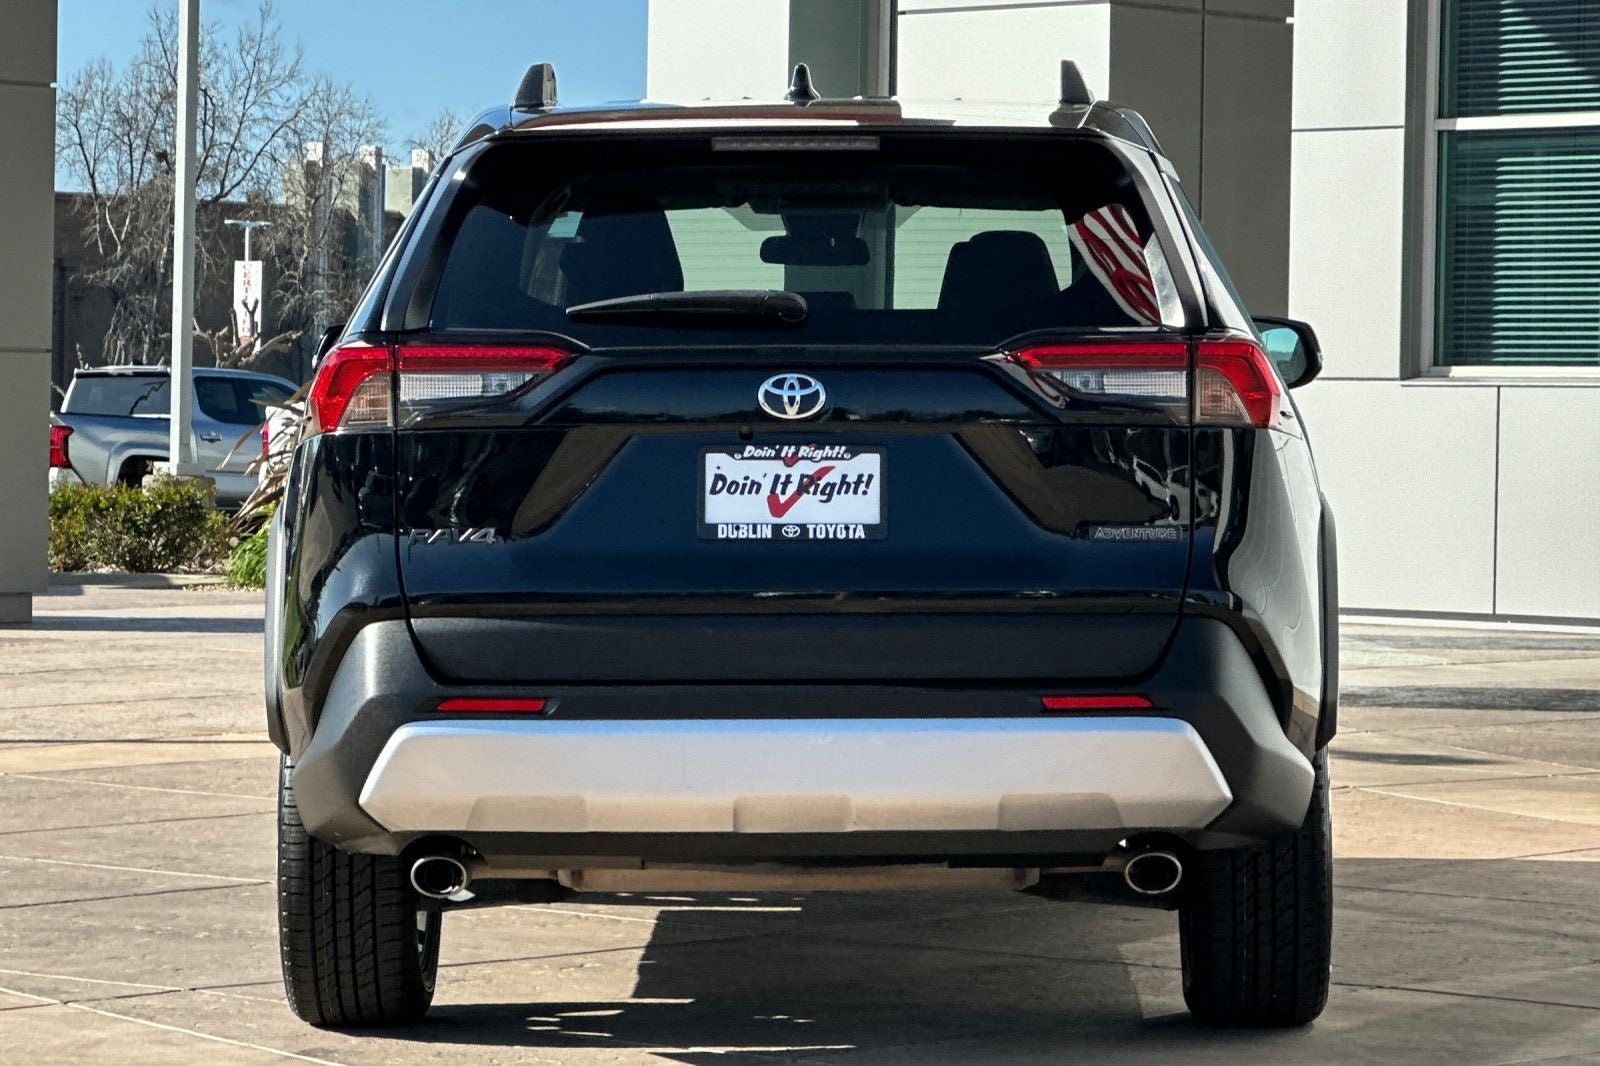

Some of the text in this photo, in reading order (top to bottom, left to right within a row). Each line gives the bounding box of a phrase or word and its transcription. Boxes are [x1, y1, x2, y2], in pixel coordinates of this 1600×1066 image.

[743, 445, 846, 462] Doin' It Right!
[709, 473, 875, 503] Doin' It Right!
[717, 524, 865, 539] DUBLIN TOYOTA
[1094, 526, 1178, 540] ADVENTURE
